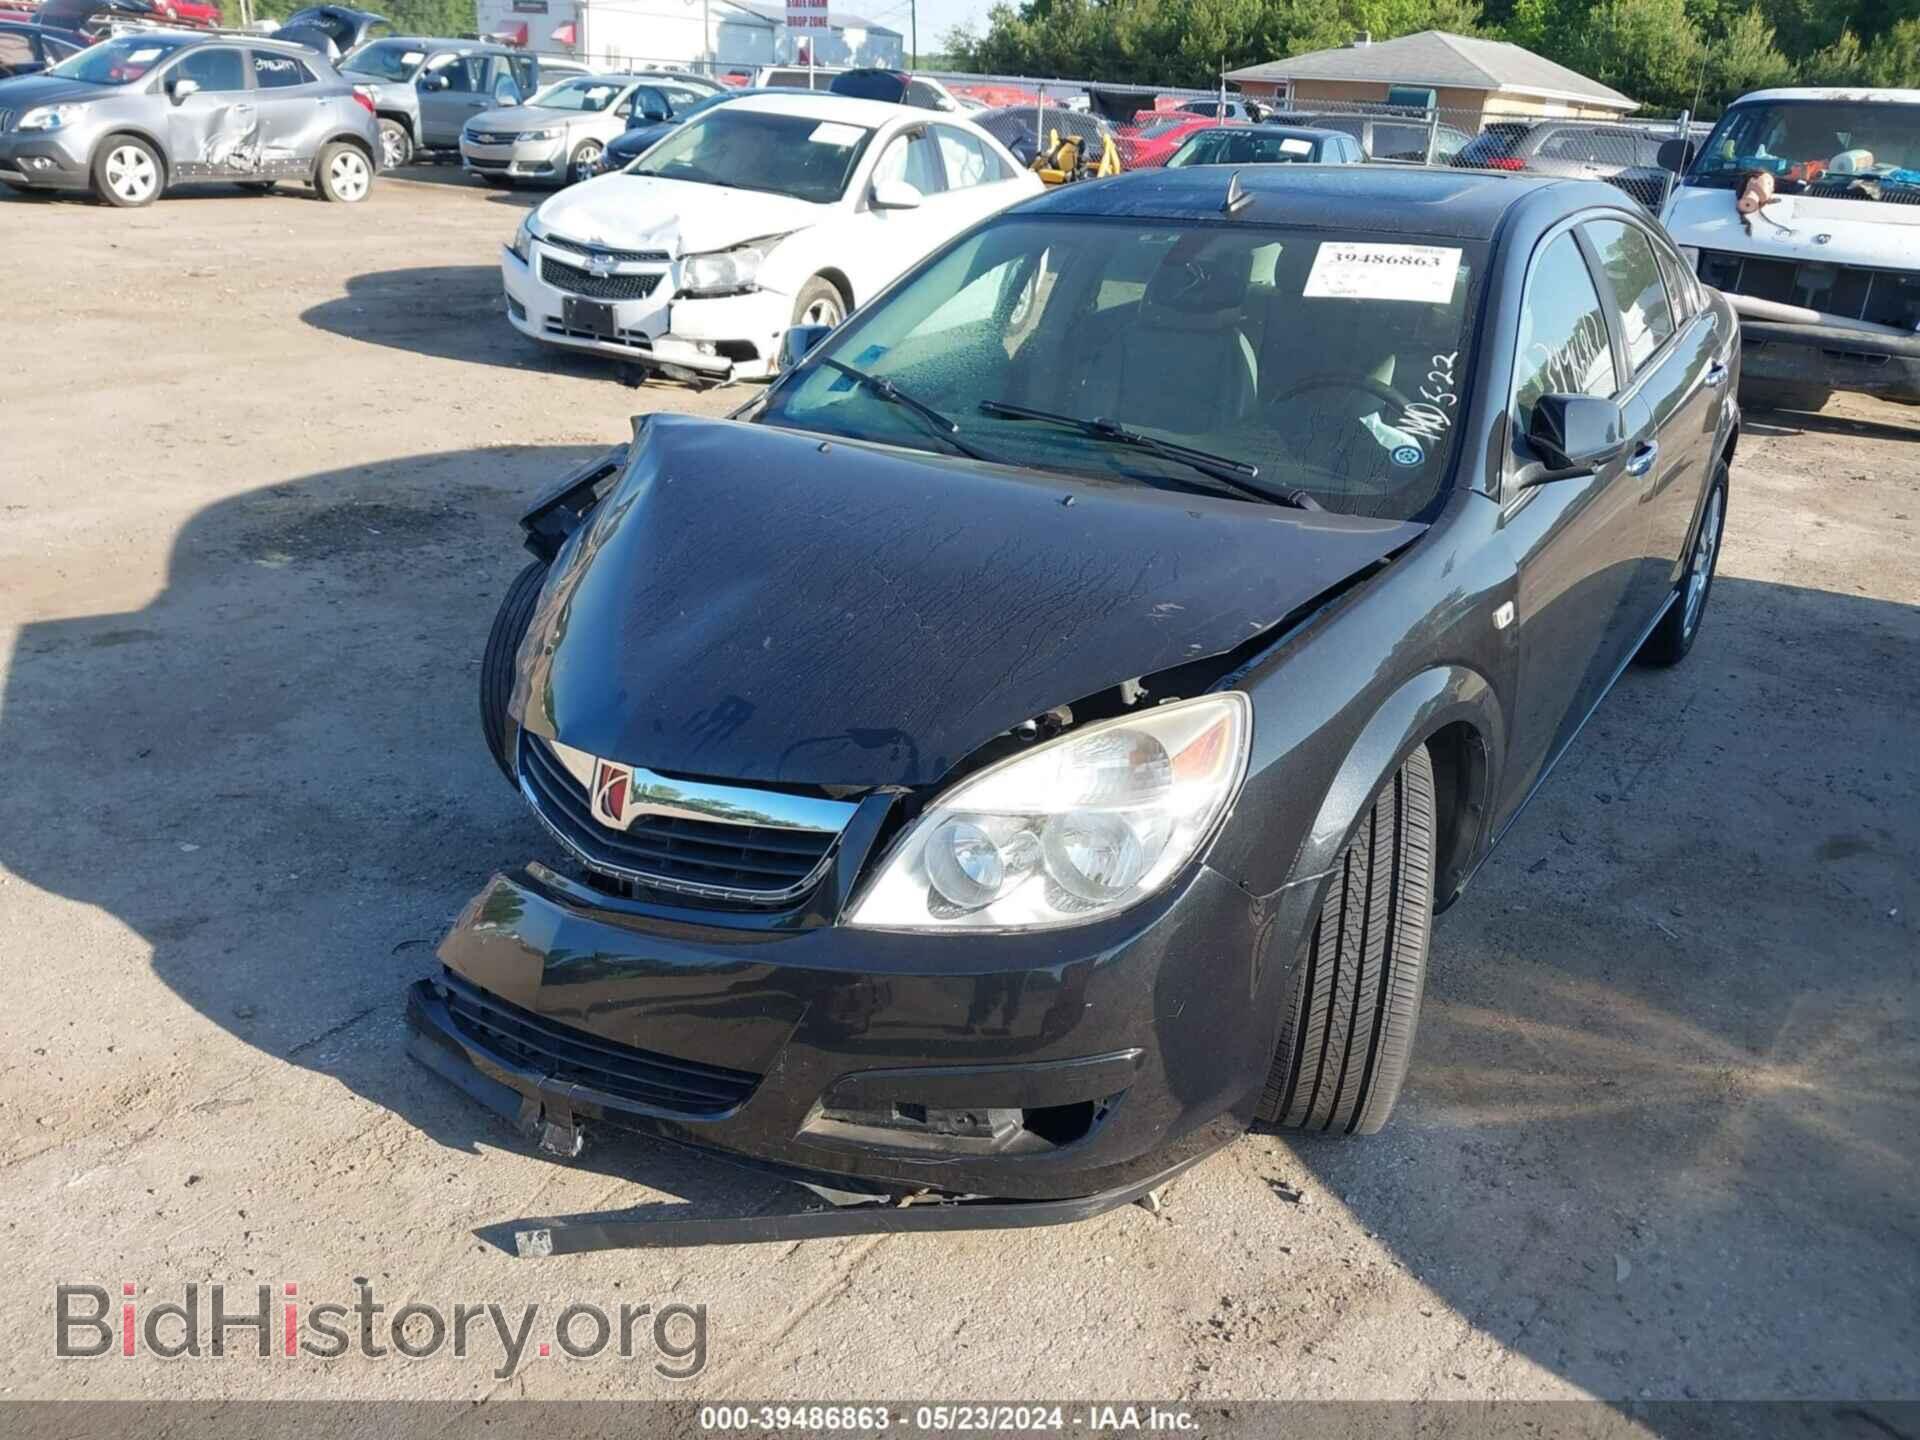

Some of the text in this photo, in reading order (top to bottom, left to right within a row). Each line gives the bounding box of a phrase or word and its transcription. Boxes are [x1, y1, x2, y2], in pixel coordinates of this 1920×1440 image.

[786, 16, 828, 27] DROP ZONE
[1331, 252, 1441, 267] 39486863
